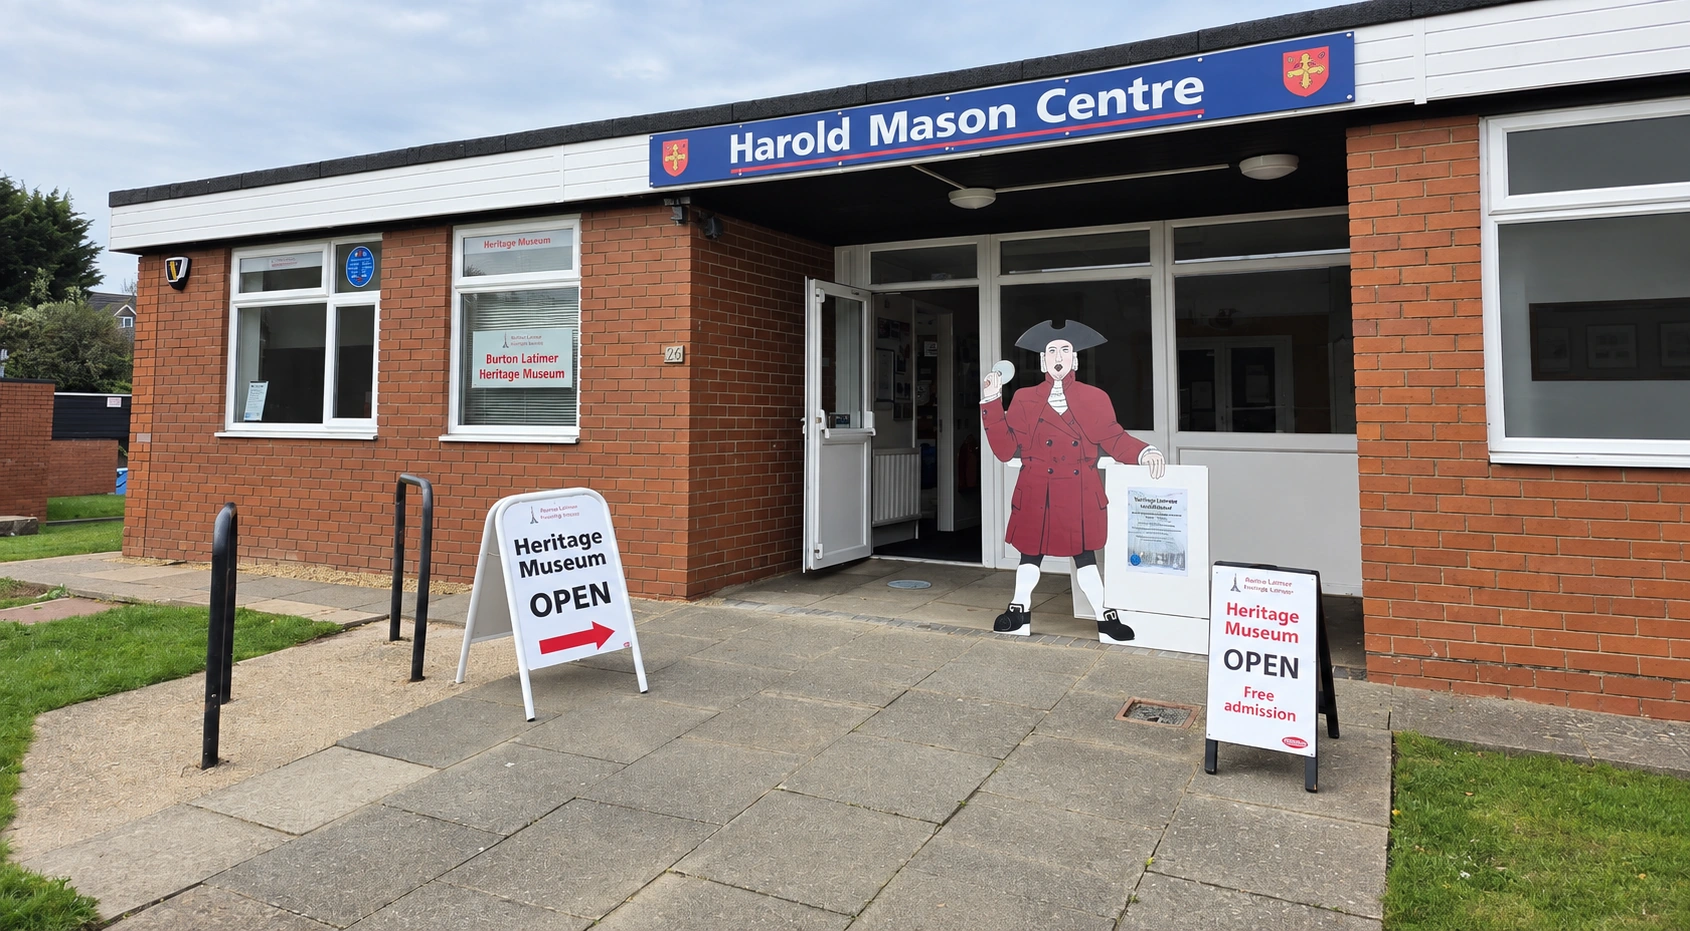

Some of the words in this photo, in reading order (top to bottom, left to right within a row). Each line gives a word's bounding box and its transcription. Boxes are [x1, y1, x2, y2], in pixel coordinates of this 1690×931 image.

[730, 116, 851, 163] Harold
[869, 98, 1017, 148] Mason
[1036, 76, 1205, 125] Centre
[483, 239, 517, 250] Heritage
[518, 237, 551, 247] Museum
[486, 353, 519, 365] Burton
[521, 353, 559, 364] Latimer
[667, 347, 682, 361] 26
[479, 369, 520, 382] Heritage
[522, 368, 565, 379] Museum
[513, 531, 603, 556] Heritage
[518, 552, 607, 579] Museum
[529, 581, 612, 618] OPEN
[1226, 602, 1300, 626] Heritage
[1225, 621, 1299, 644] Museum
[1223, 648, 1299, 679] OPEN
[1243, 686, 1275, 702] Free
[1223, 701, 1297, 722] admission
